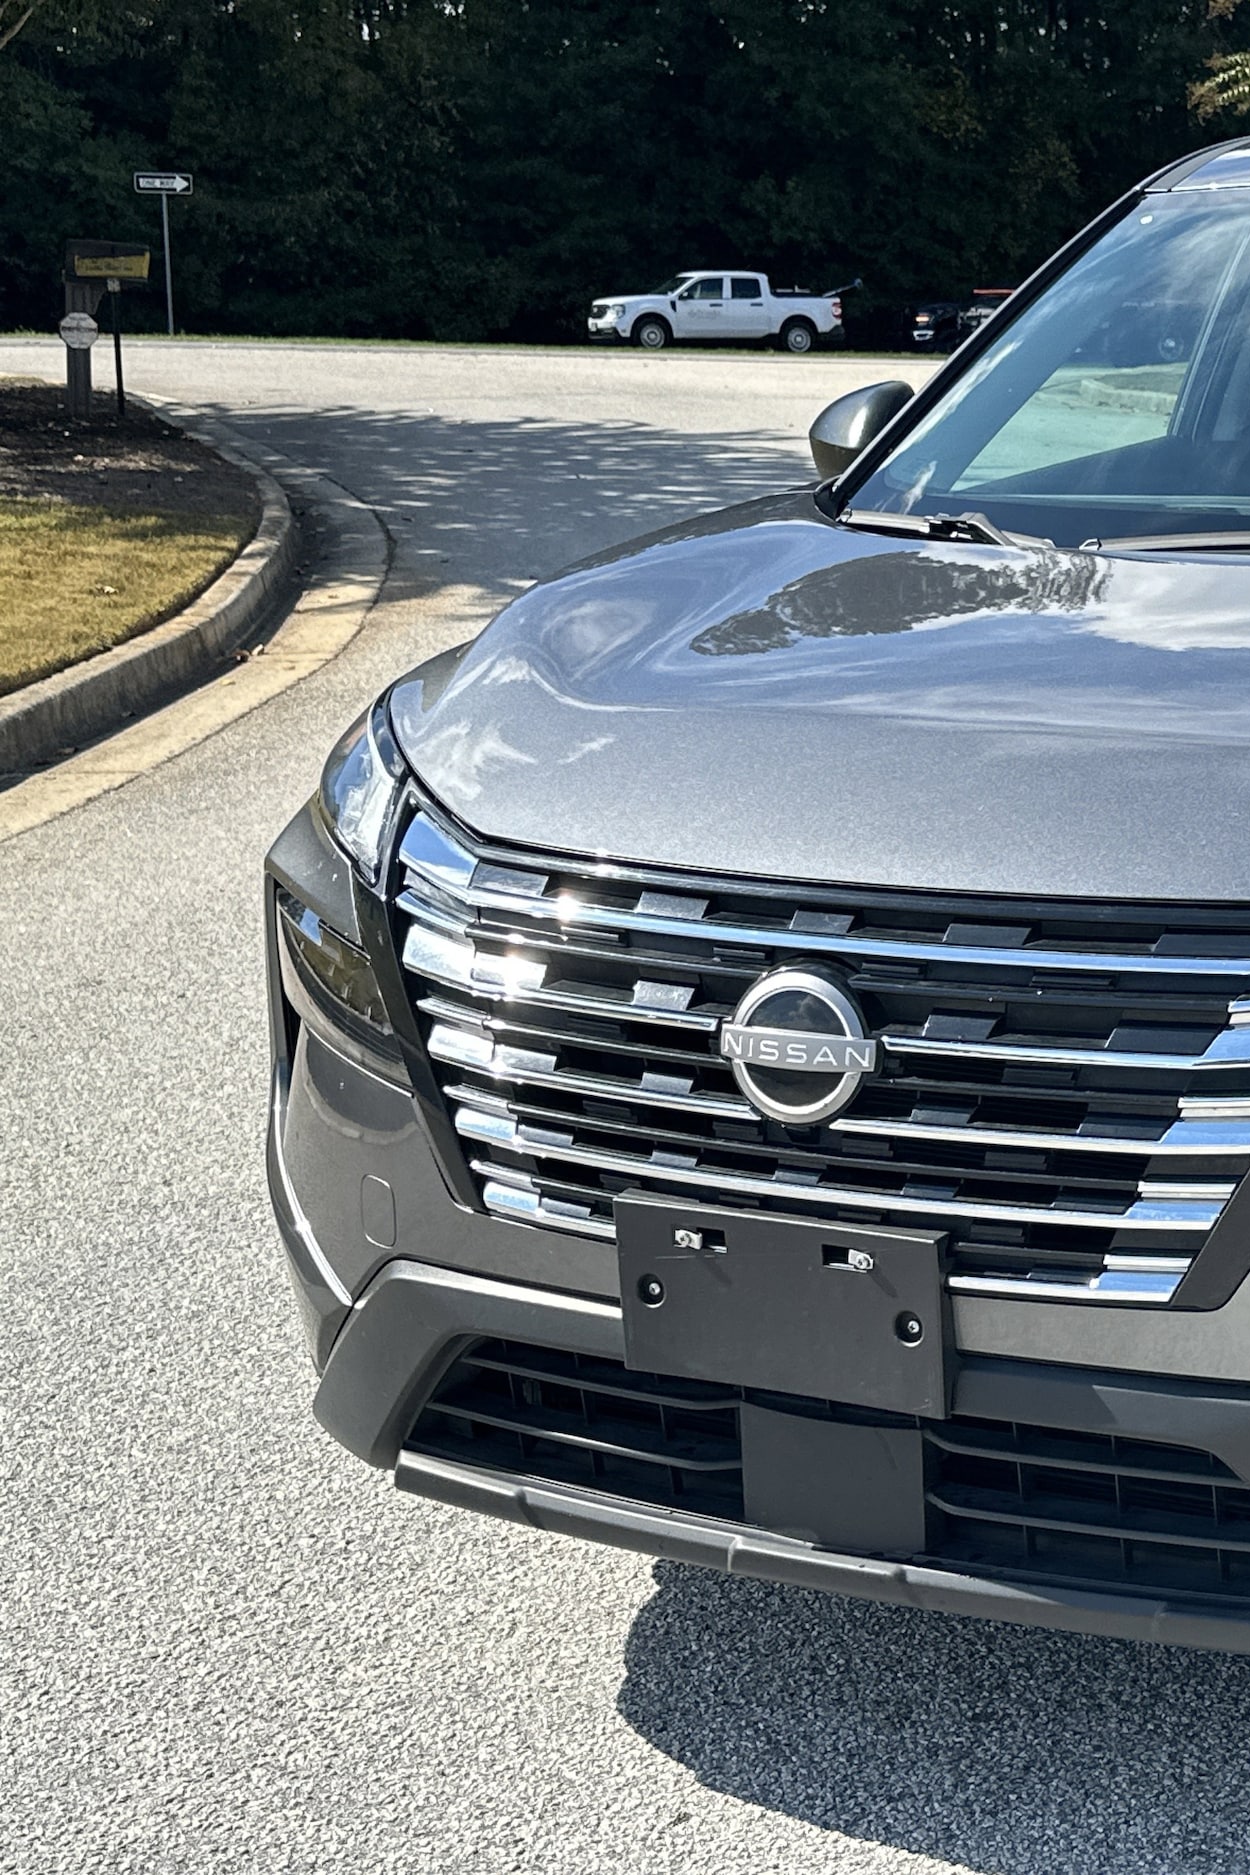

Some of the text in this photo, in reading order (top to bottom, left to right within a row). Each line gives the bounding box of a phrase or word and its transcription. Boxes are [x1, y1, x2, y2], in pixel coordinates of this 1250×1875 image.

[141, 179, 175, 189] ONE WAY
[723, 1032, 871, 1068] NISSAN
